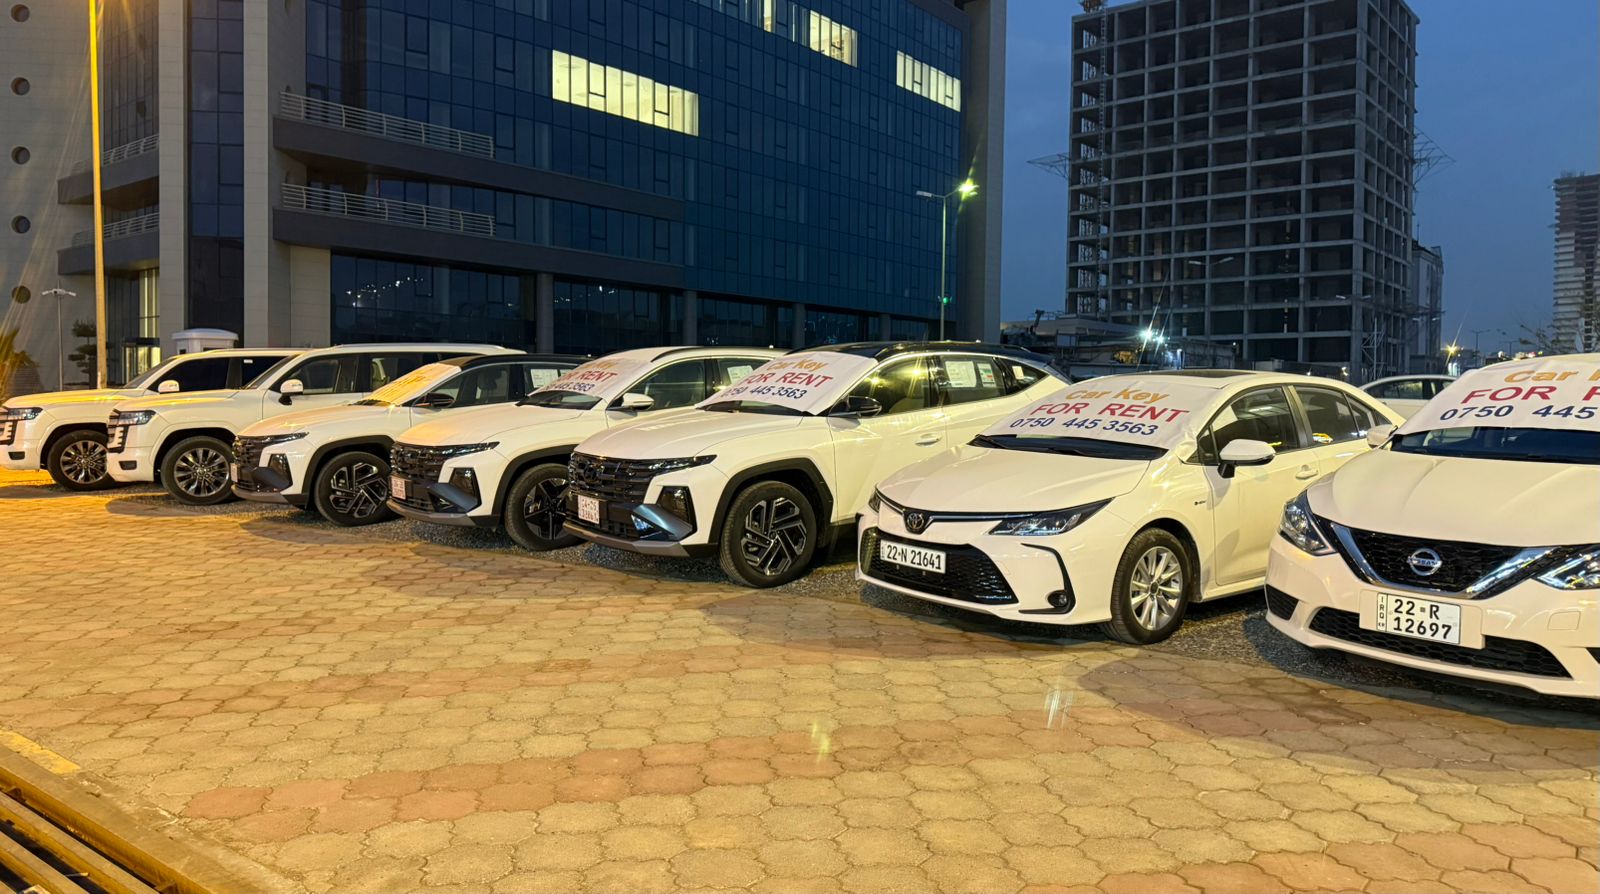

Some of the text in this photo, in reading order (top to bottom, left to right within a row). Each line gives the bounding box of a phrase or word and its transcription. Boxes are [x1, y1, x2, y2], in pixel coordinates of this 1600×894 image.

[776, 371, 834, 388] RENT
[1504, 370, 1579, 383] Car
[749, 385, 775, 396] 445
[772, 386, 808, 399] 3563
[1065, 388, 1170, 404] Car Key
[1461, 386, 1557, 404] FOR
[1029, 402, 1190, 423] FOR RENT
[1440, 405, 1598, 420] 0750 445
[1009, 417, 1159, 436] 0750 445 3563
[910, 549, 942, 570] 21641
[1393, 616, 1452, 639] 12697
